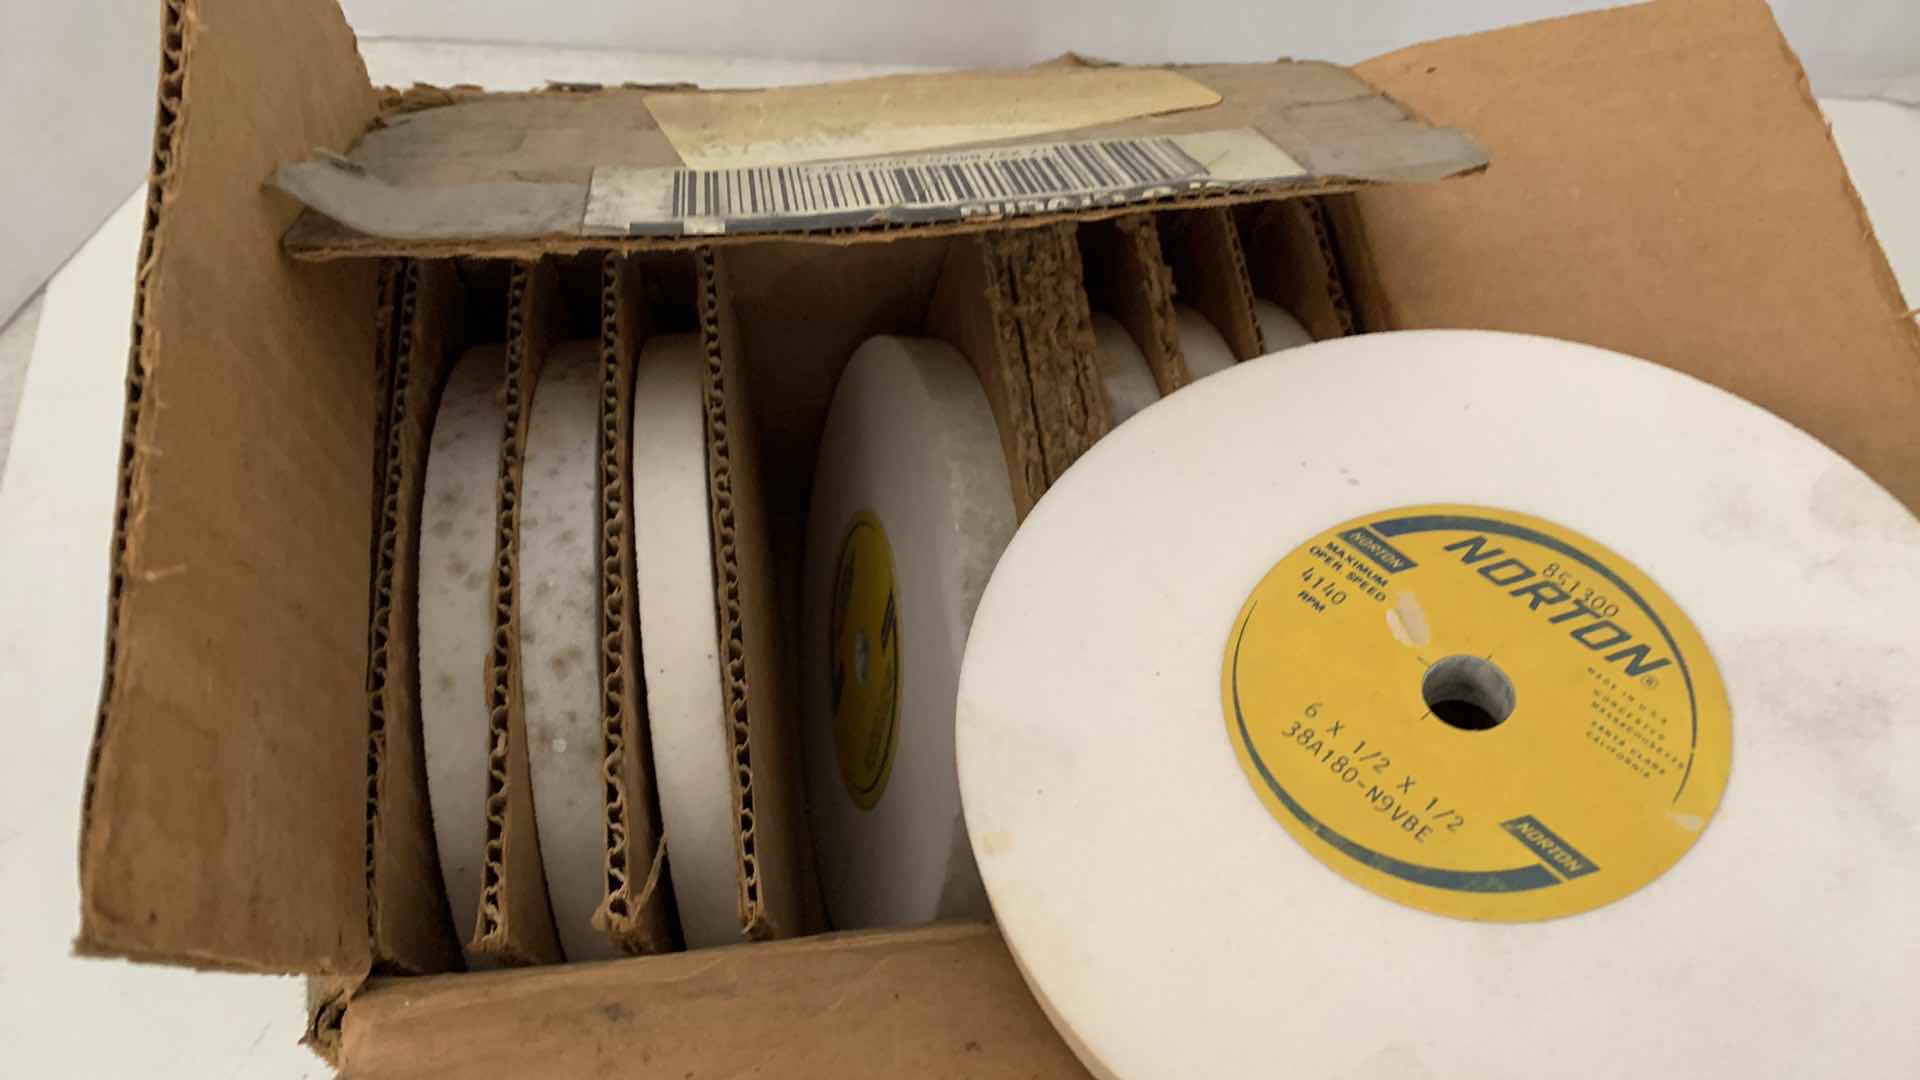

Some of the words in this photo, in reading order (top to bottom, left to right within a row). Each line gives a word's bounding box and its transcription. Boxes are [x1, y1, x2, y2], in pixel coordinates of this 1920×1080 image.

[1302, 567, 1347, 605] 4140
[1326, 541, 1389, 587] MAXIMUM
[1346, 571, 1386, 602] SPEED
[1298, 590, 1326, 613] RPM
[1443, 535, 1673, 677] NORTON
[1541, 562, 1620, 619] 851300
[1281, 720, 1434, 843] 38A180-N9VBE
[1304, 702, 1323, 718] 6
[1353, 740, 1391, 774] 1/2
[1425, 796, 1464, 832] 1/2
[1516, 822, 1584, 873] NORTON
